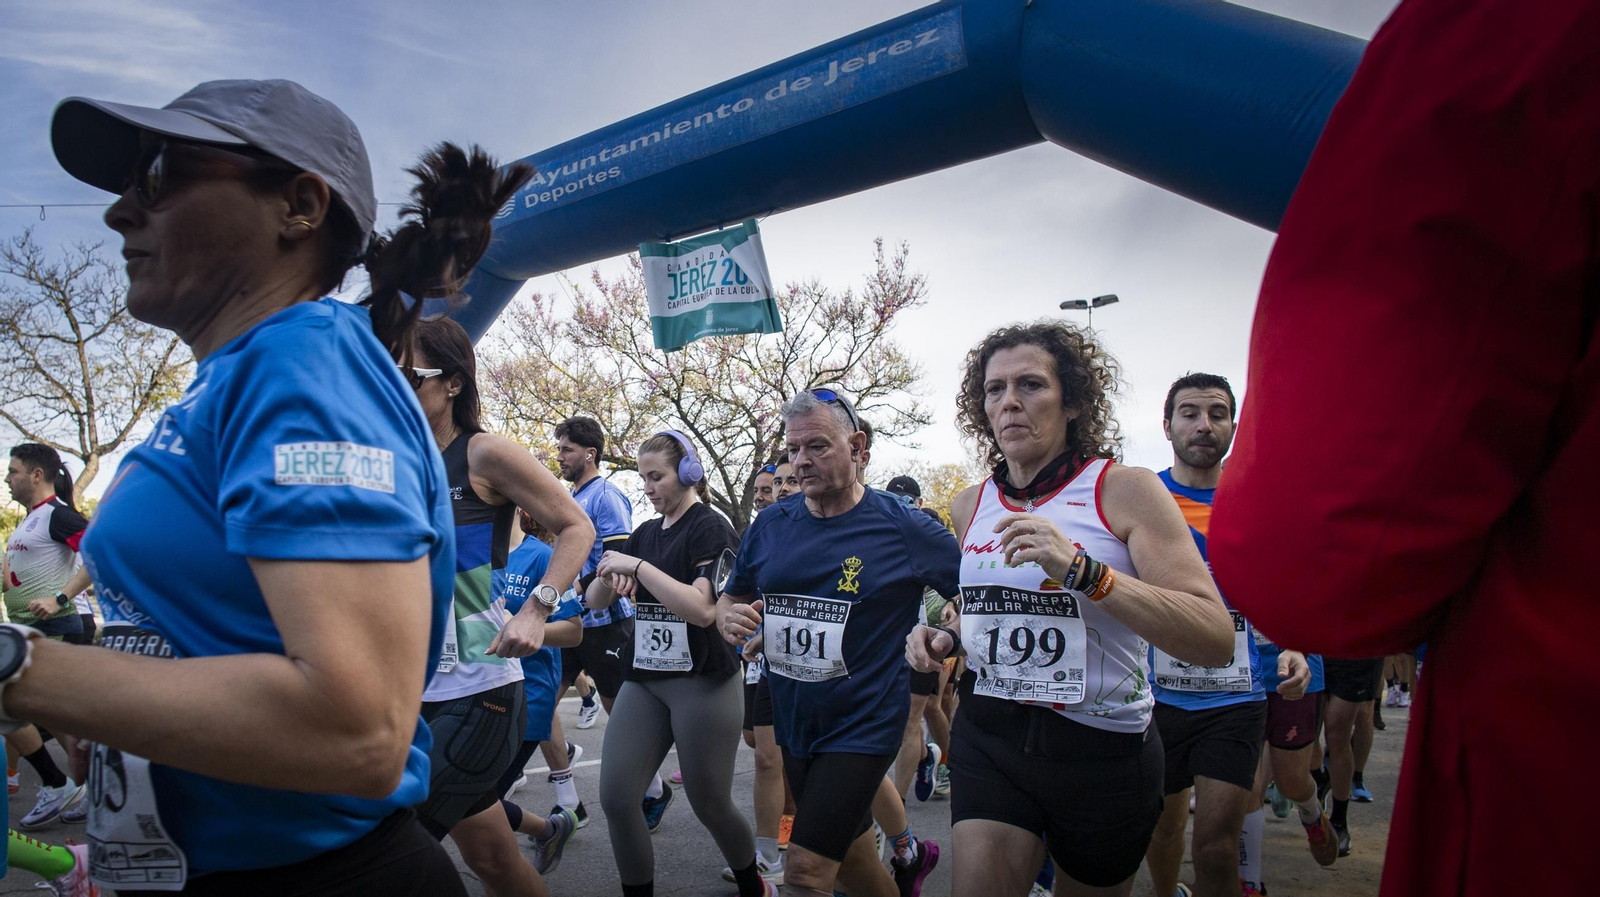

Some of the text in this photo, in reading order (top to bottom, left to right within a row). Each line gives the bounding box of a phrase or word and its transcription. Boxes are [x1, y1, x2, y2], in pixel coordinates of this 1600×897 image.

[524, 28, 940, 191] Ayuntamiento de Jerez
[524, 166, 621, 209] Deportes
[667, 260, 718, 300] JEREZ
[667, 298, 690, 310] CAPITAL
[715, 287, 725, 296] DE
[728, 286, 738, 295] LA
[278, 451, 394, 483] JEREZ 2031
[502, 585, 527, 598] REZ
[505, 573, 530, 586] ERA
[768, 597, 846, 613] XLV CARRERA
[965, 602, 1075, 617] POPULAR JEREZ
[1002, 590, 1072, 605] CARRERA
[768, 605, 844, 622] POPULAR JEREZ
[650, 628, 673, 652] 59
[782, 626, 828, 660] 191
[984, 626, 1066, 668] 199
[482, 700, 507, 713] WONG
